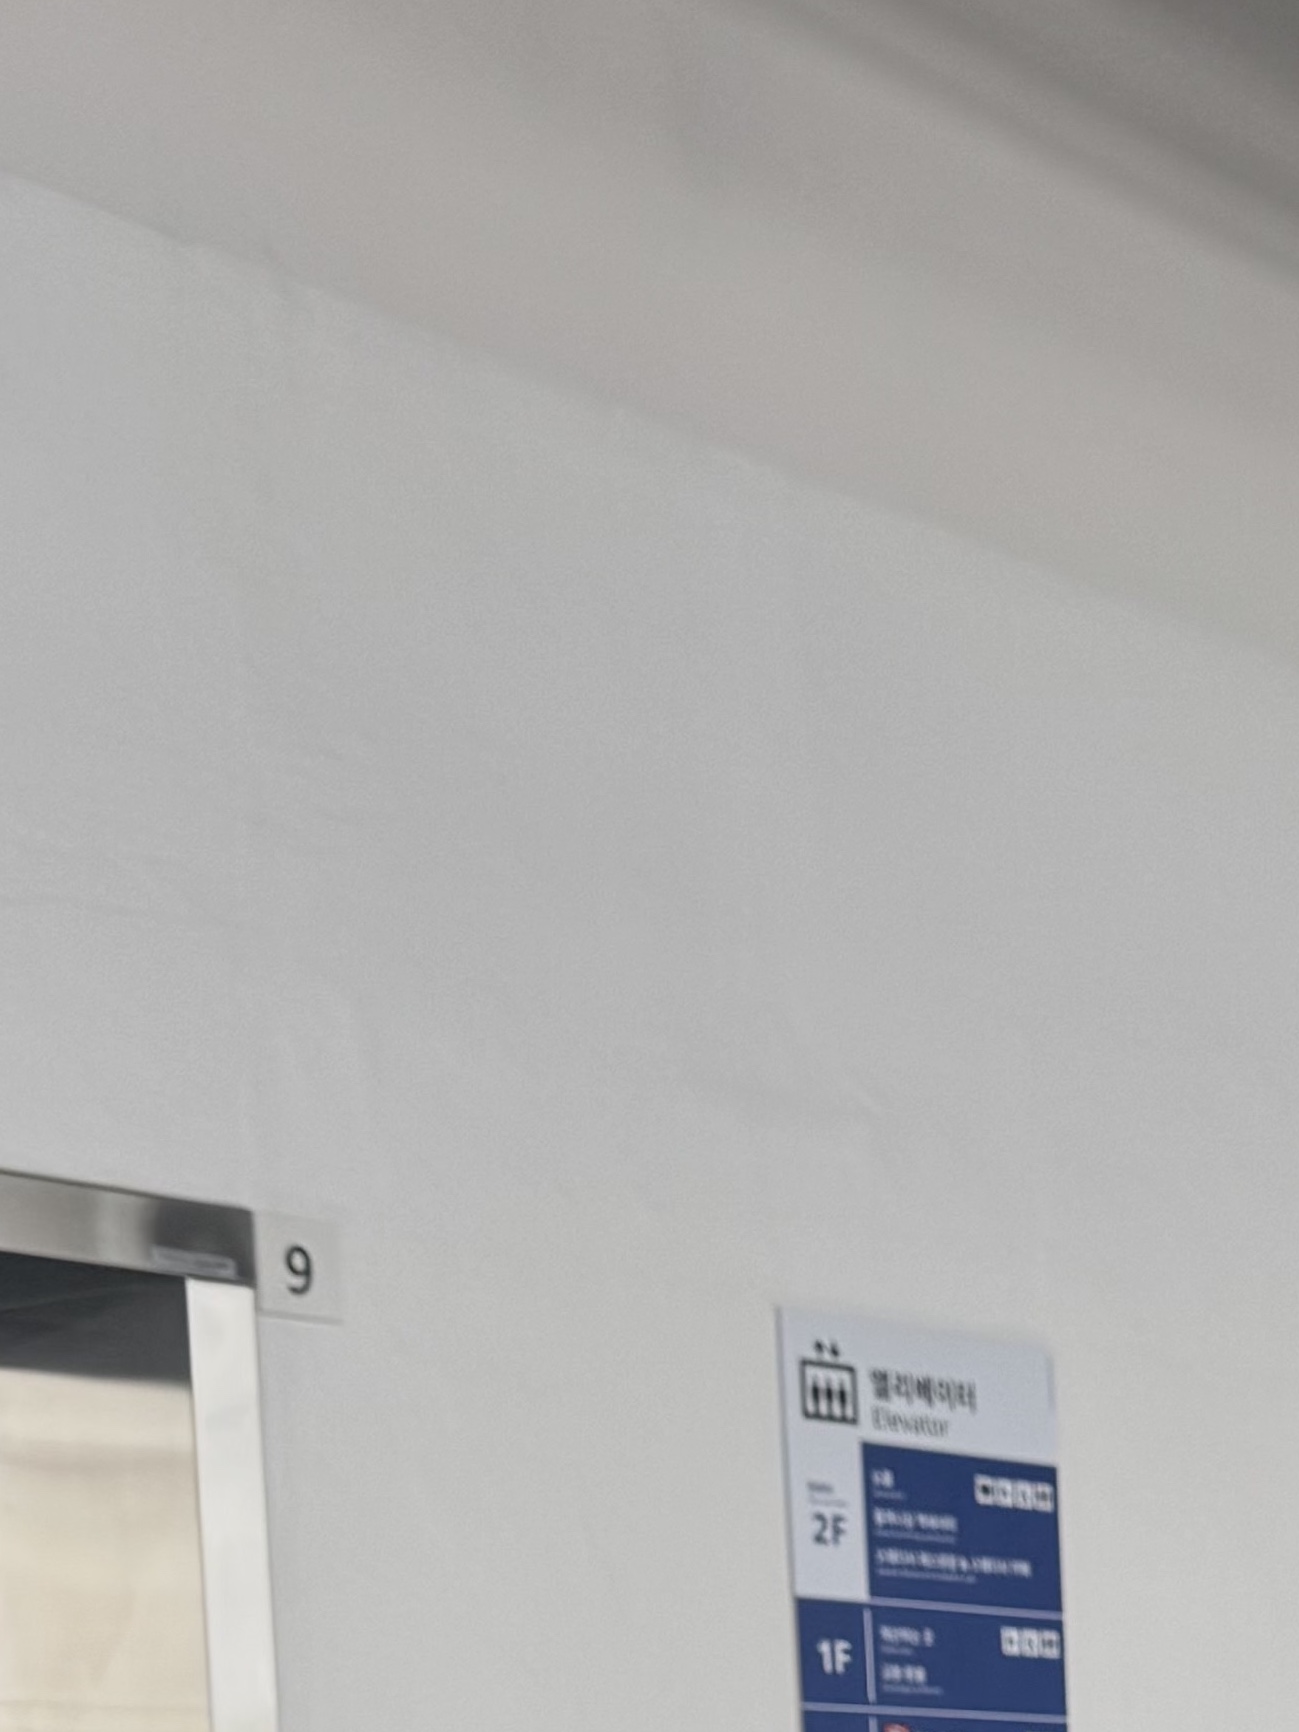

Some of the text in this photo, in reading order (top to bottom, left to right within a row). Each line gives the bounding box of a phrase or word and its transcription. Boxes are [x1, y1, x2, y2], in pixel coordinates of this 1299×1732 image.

[286, 1245, 312, 1295] 9
[811, 1511, 848, 1547] 2F
[816, 1638, 853, 1675] 1F
